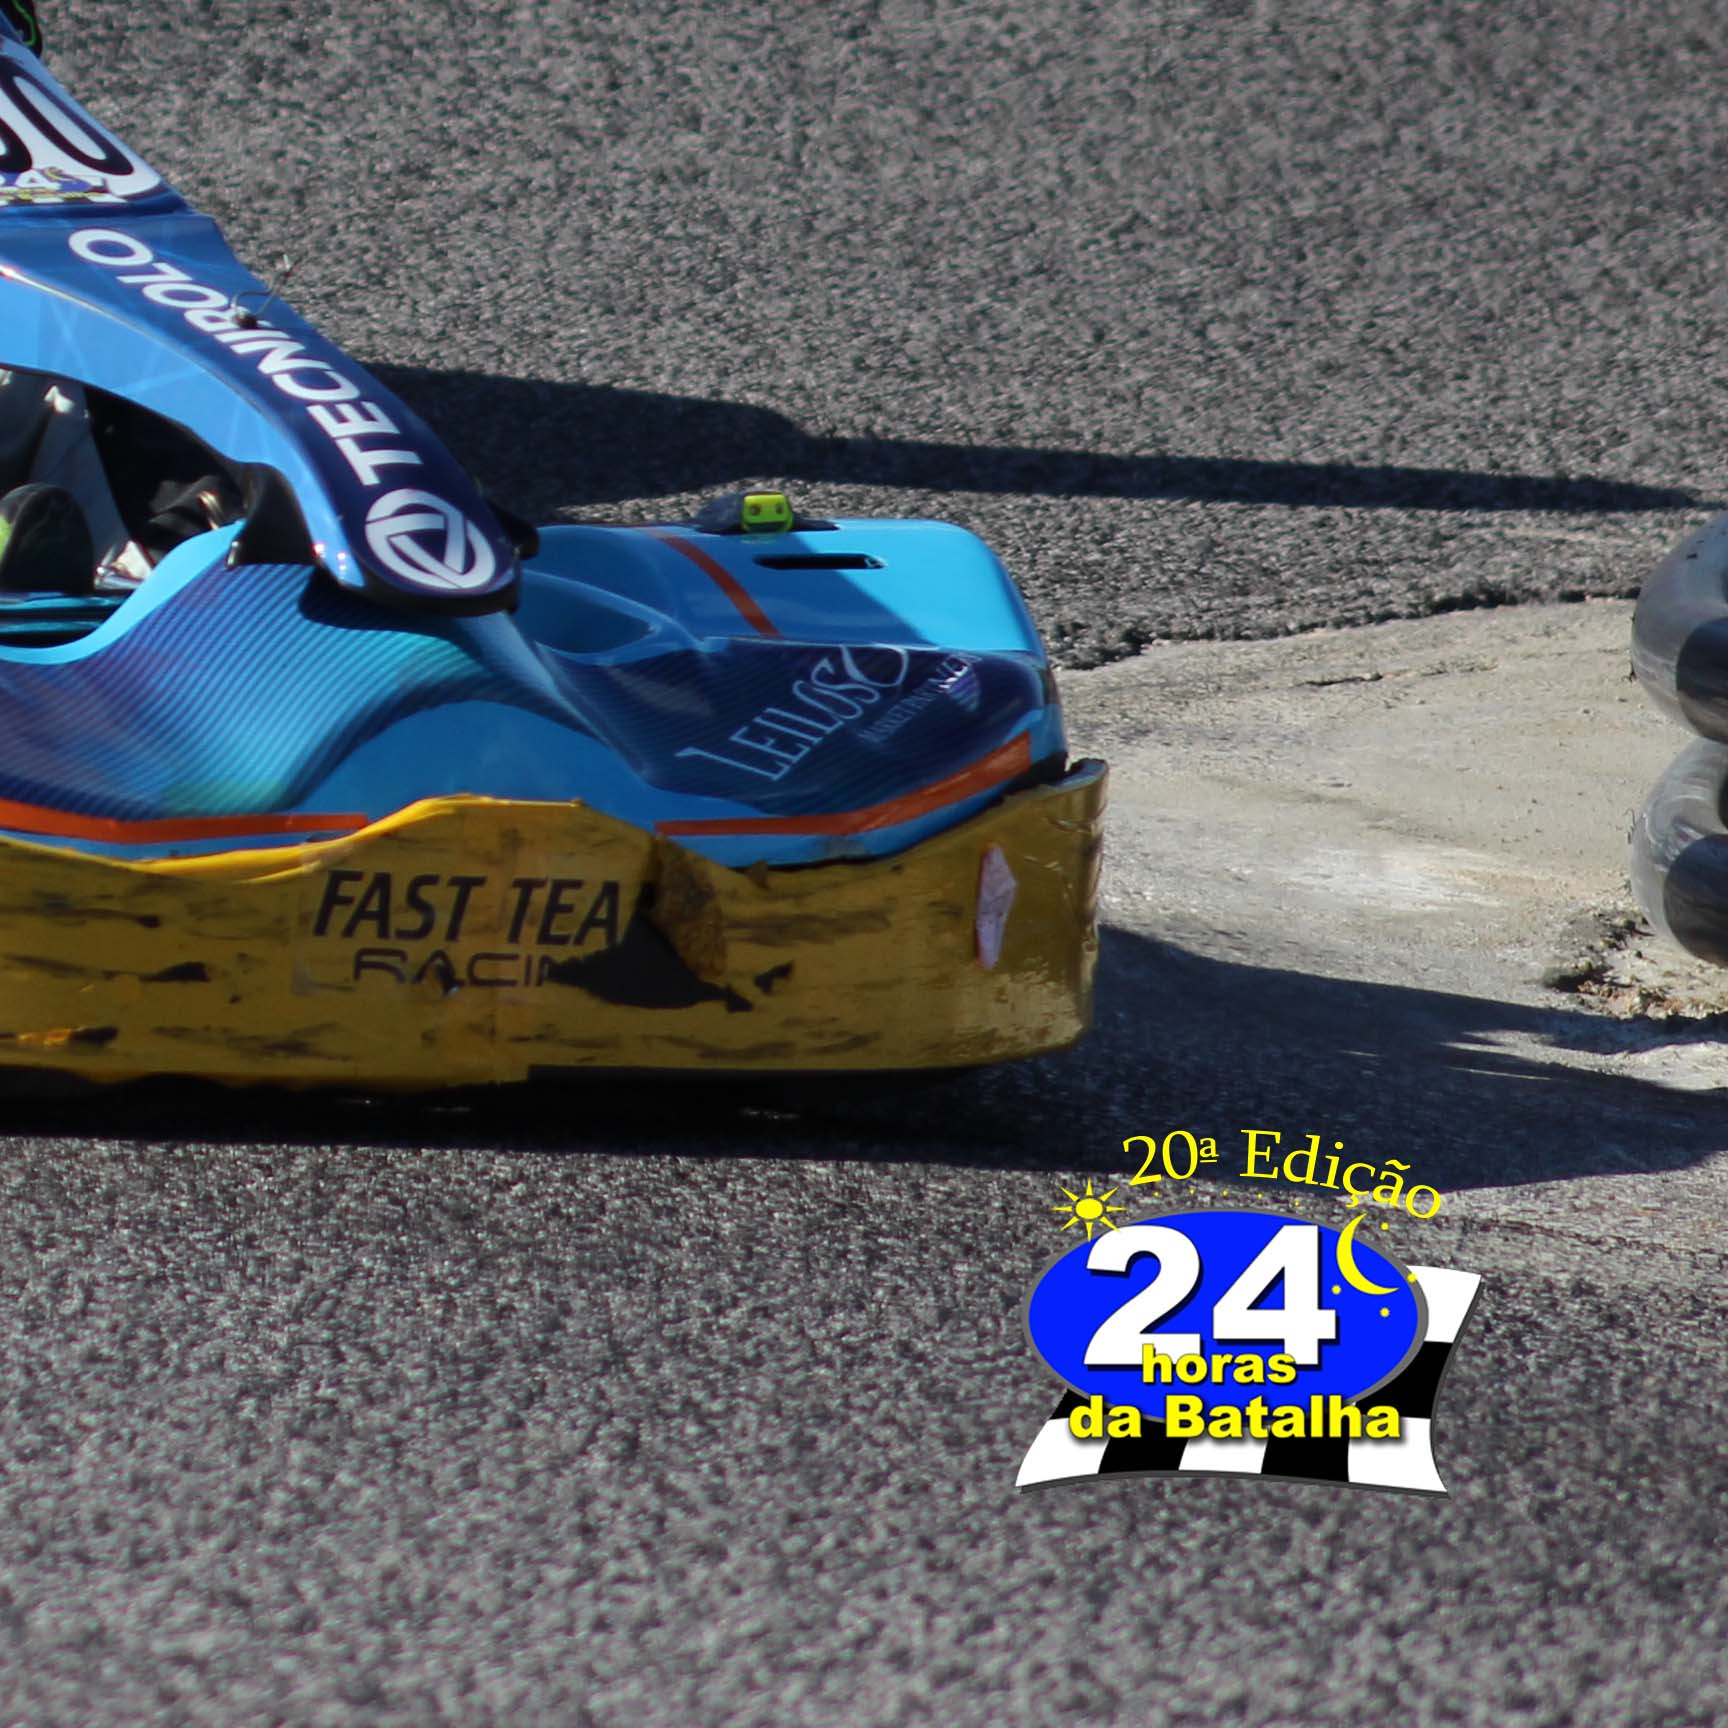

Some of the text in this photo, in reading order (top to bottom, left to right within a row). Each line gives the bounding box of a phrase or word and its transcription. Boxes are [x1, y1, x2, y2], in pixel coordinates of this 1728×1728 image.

[67, 228, 424, 487] TECNIROLO
[313, 868, 624, 947] FAST TEA
[353, 946, 552, 997] RACI
